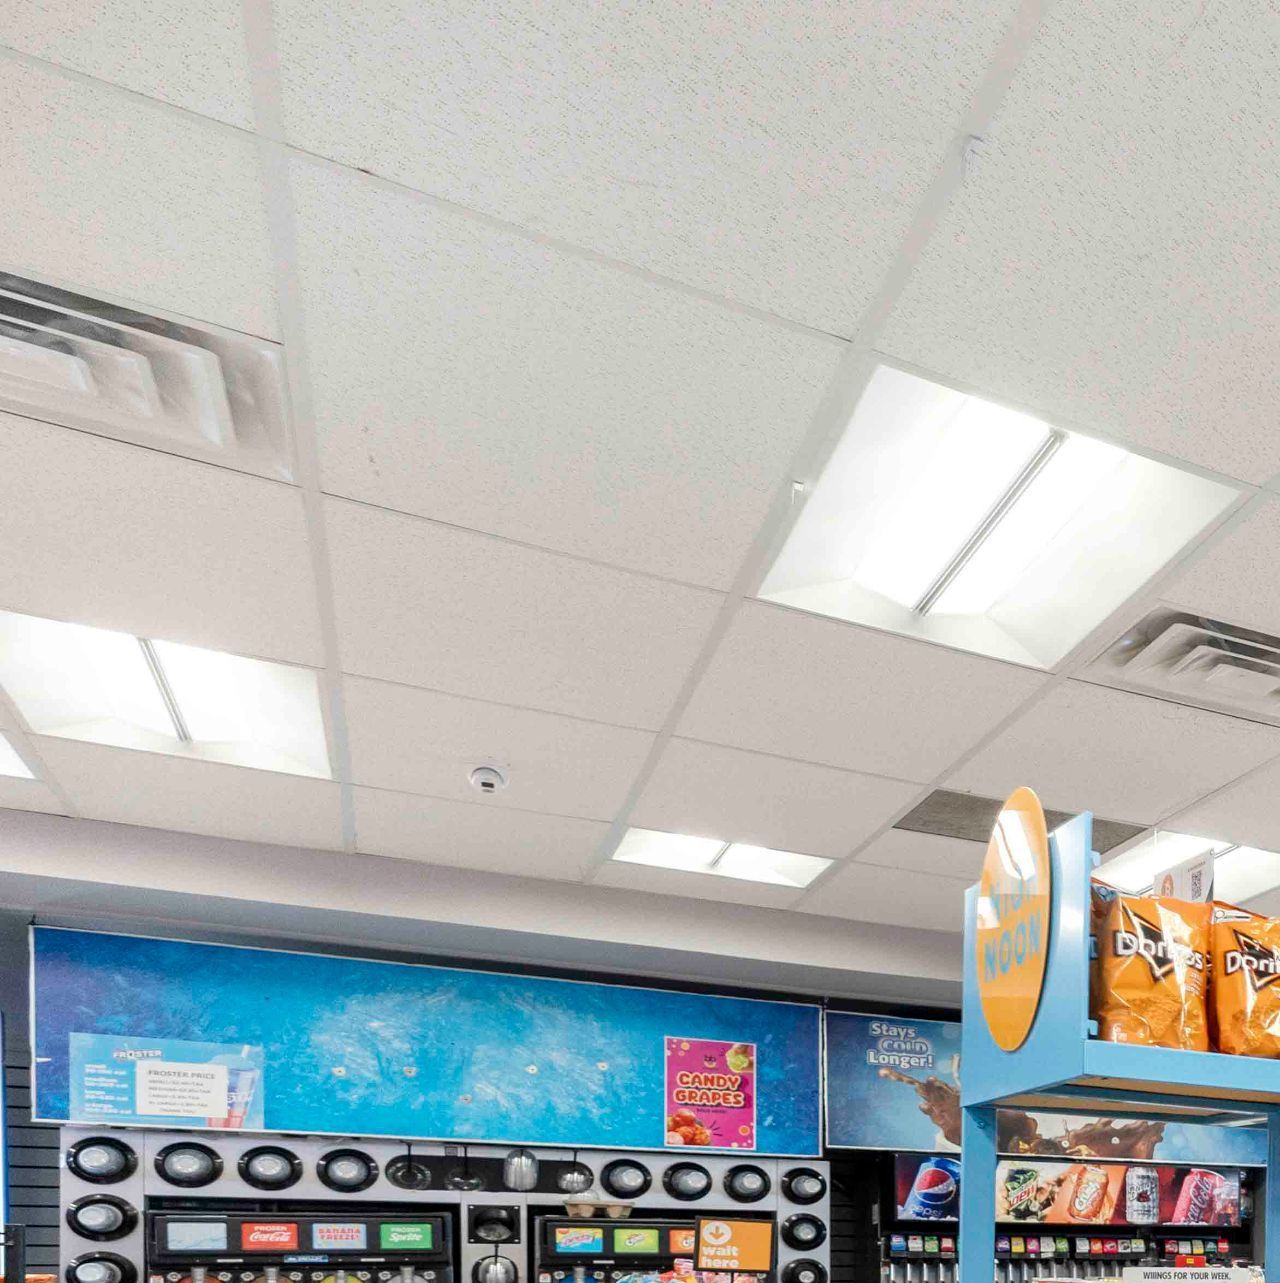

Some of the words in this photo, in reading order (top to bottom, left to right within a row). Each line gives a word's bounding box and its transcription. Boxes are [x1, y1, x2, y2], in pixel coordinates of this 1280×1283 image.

[984, 912, 1041, 983] NOON
[870, 1021, 916, 1039] Stays
[881, 1037, 929, 1053] COLD
[867, 1051, 934, 1069] Longer!
[148, 1070, 189, 1079] FROSTER
[191, 1071, 217, 1080] PRICE
[677, 1071, 740, 1090] CANDY
[674, 1089, 745, 1107] GRAPES
[388, 1232, 423, 1243] Sprite
[702, 1246, 740, 1257] wait
[702, 1256, 740, 1268] here
[1173, 1271, 1188, 1280] FOR
[1190, 1271, 1210, 1280] YOUR
